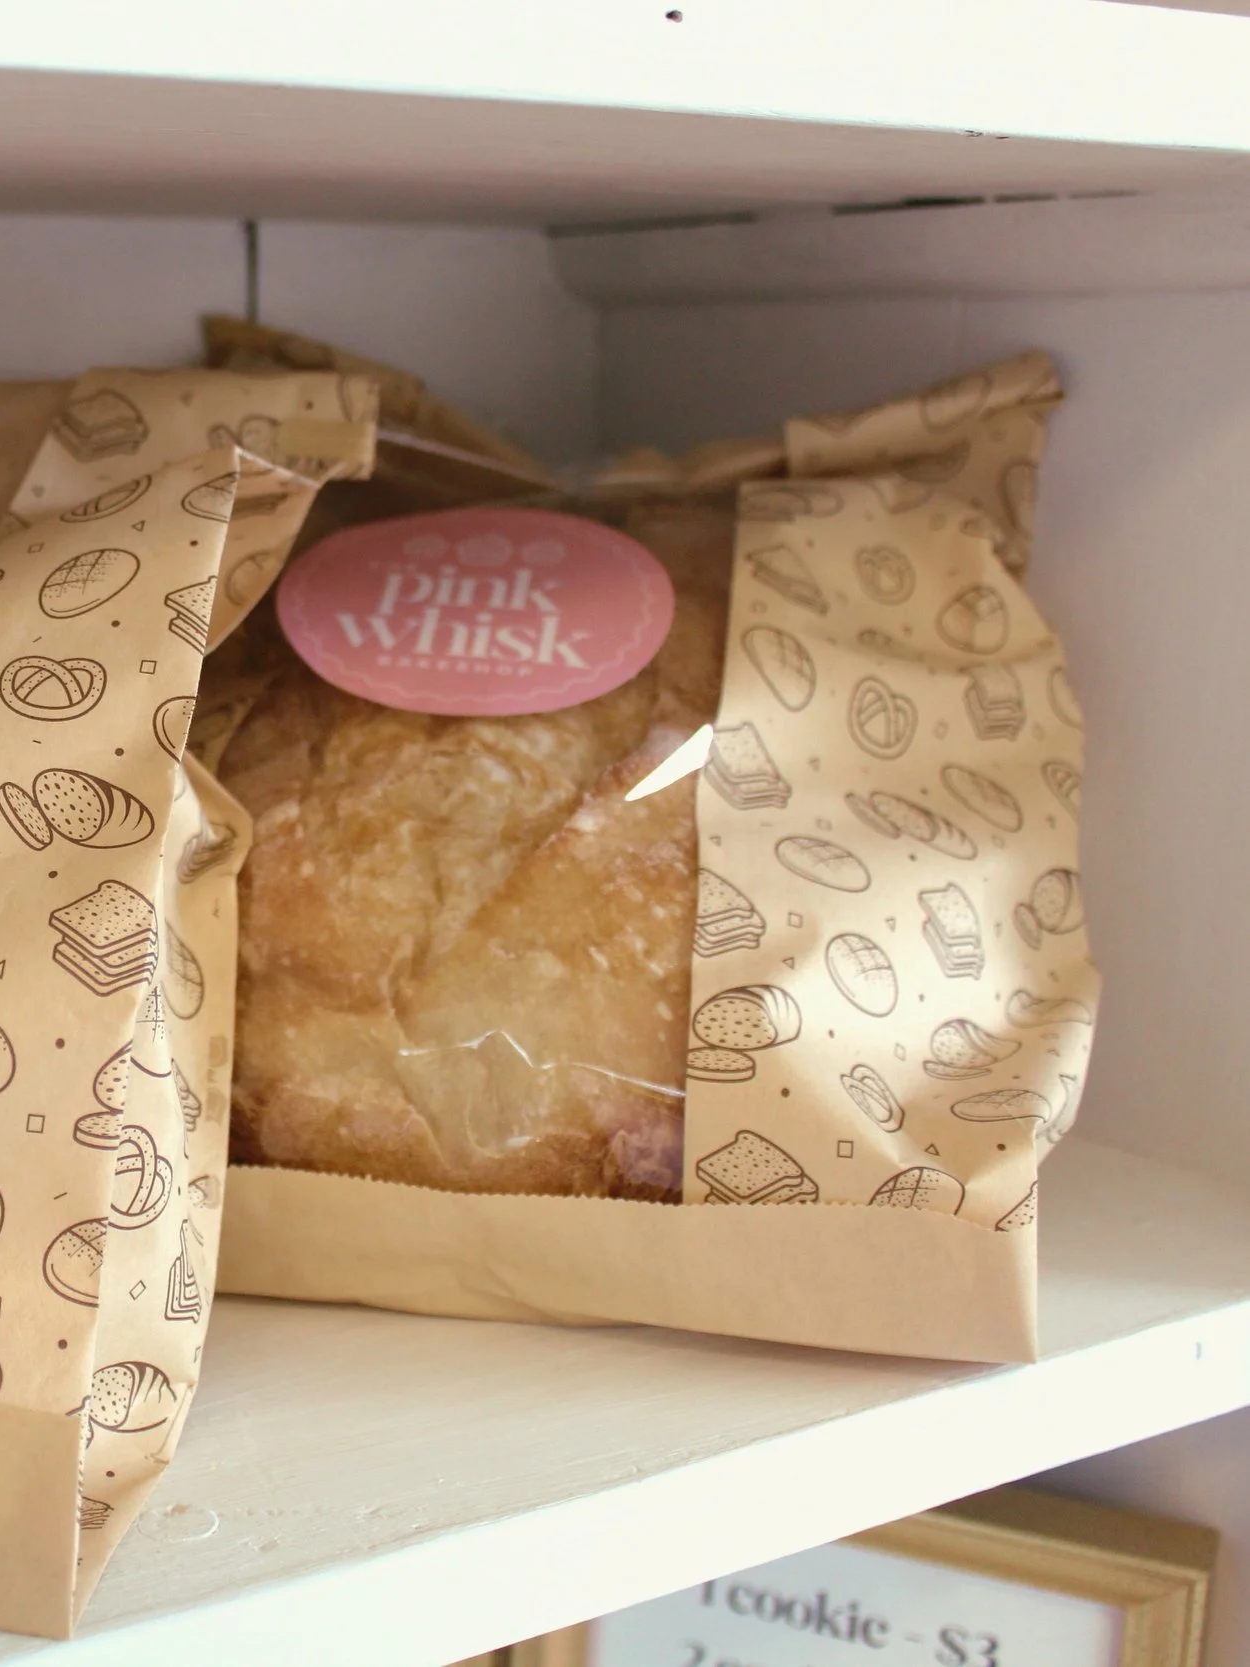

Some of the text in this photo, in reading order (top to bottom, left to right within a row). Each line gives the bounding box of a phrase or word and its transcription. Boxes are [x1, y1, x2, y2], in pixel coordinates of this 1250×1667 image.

[378, 565, 561, 615] pink
[335, 607, 591, 671] whisk
[724, 1580, 892, 1650] cookie
